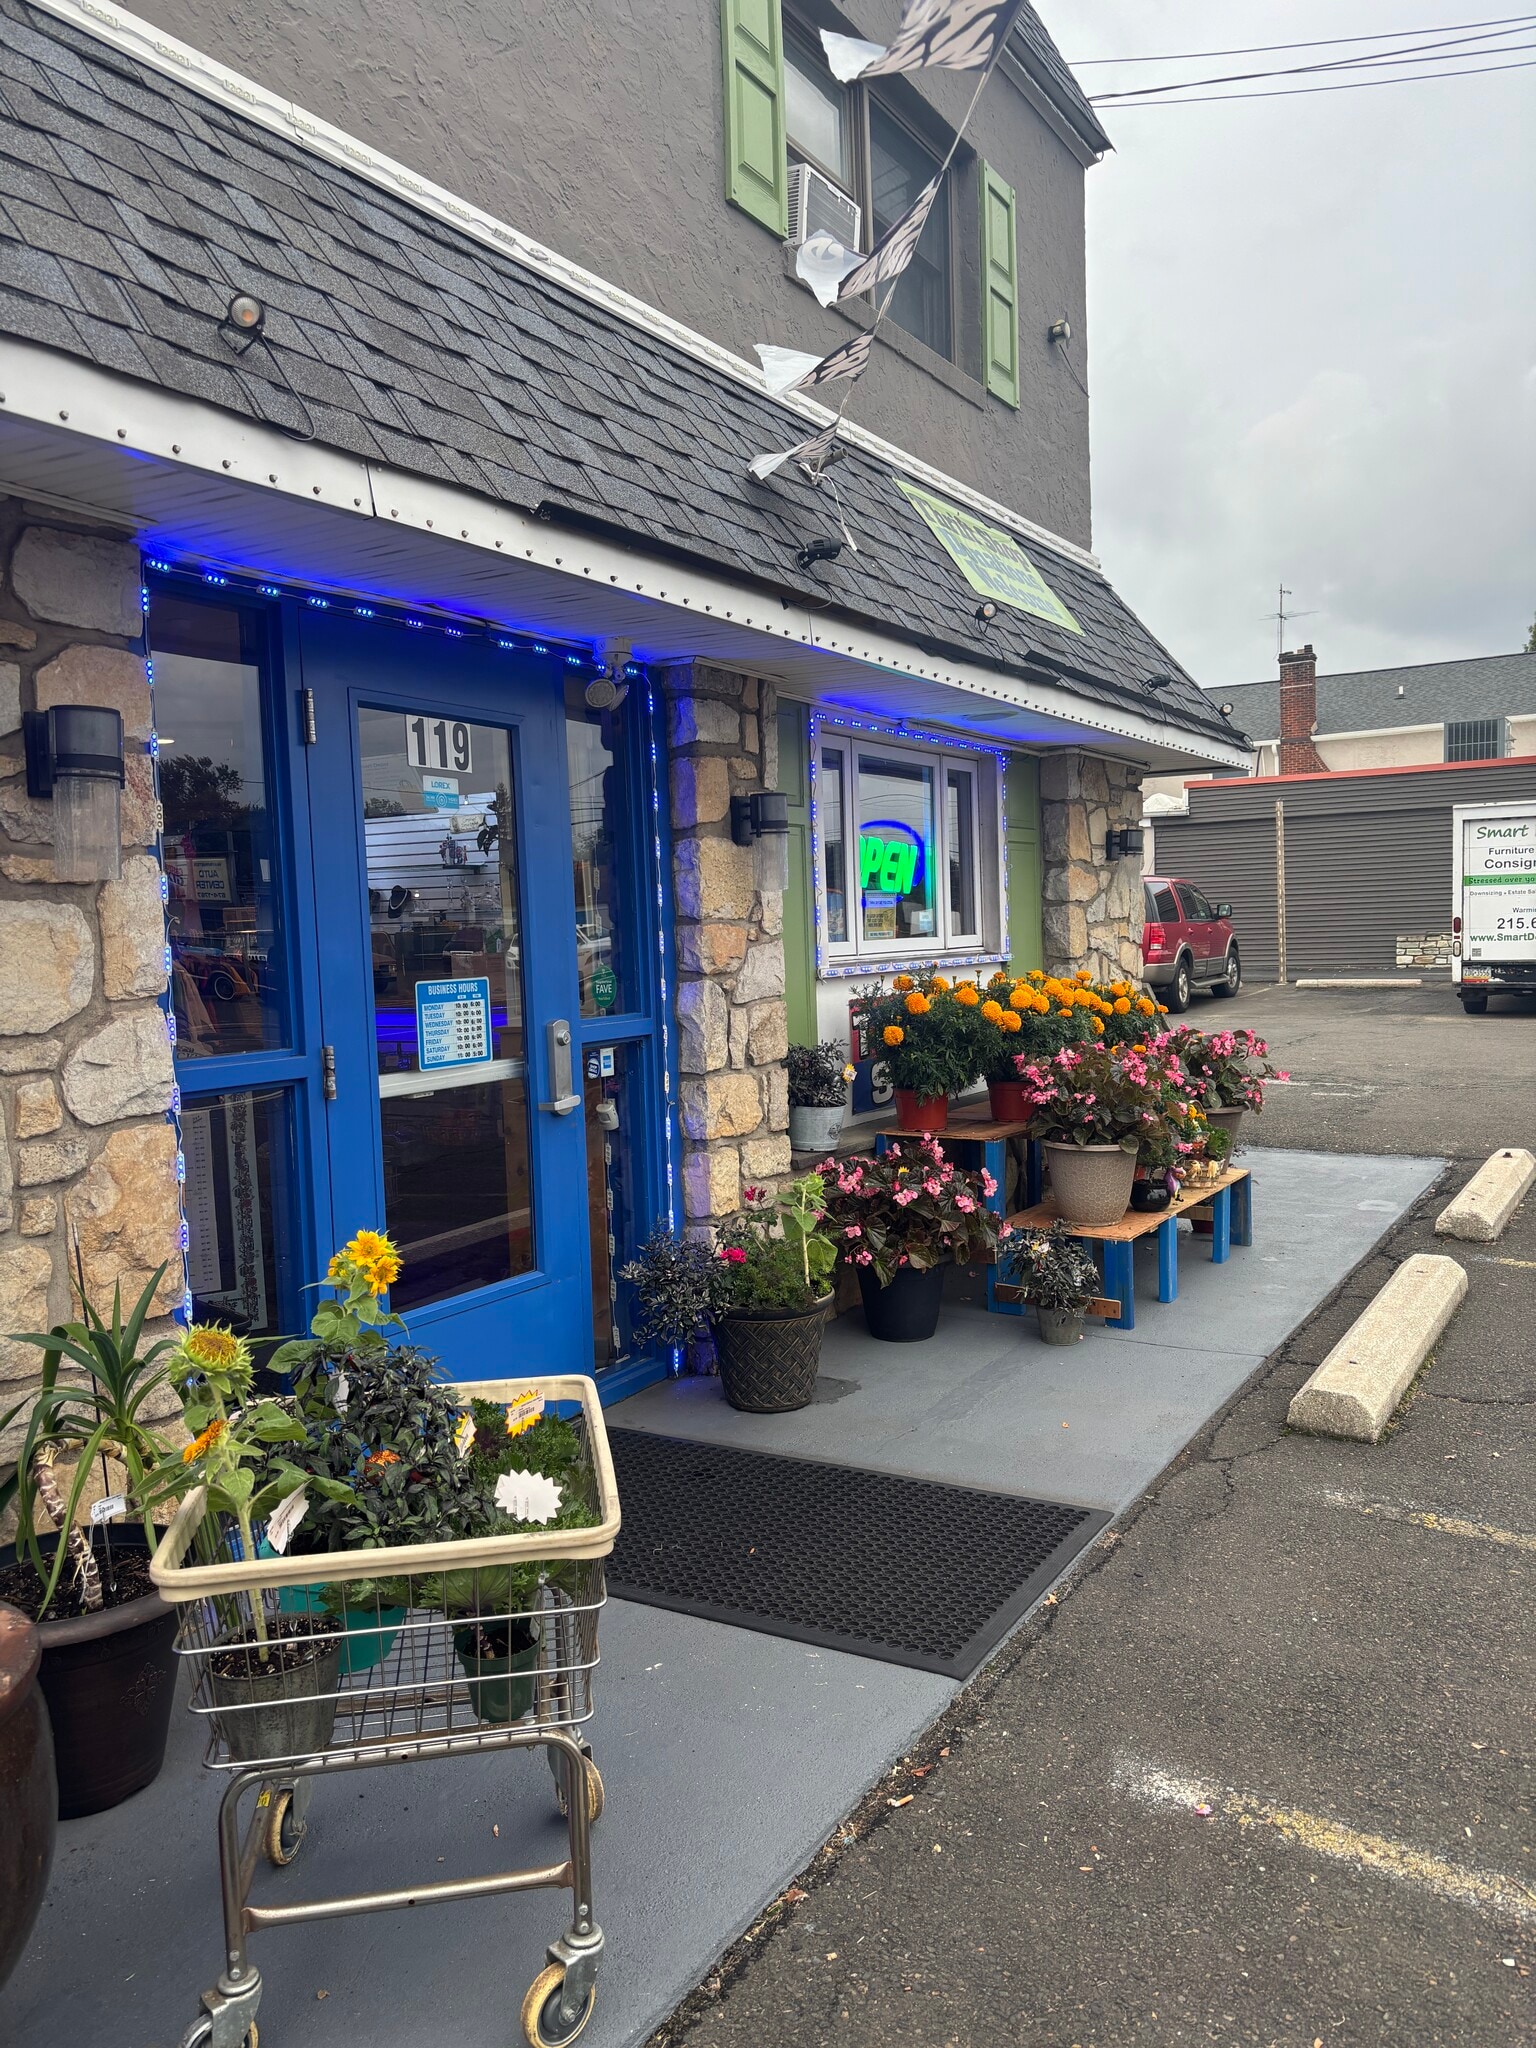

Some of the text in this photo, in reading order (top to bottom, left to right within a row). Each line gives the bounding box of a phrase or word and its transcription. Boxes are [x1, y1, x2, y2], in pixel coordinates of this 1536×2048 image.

[905, 491, 1032, 573] Thrift Shop
[937, 526, 1045, 594] Donations
[964, 558, 1063, 620] Welcome
[411, 717, 470, 771] 119
[431, 780, 451, 790] LOREX
[1476, 824, 1530, 840] Smart
[1488, 846, 1535, 855] Furniture
[1468, 876, 1503, 885] Stressed
[1469, 932, 1536, 942] www.SmartD
[428, 982, 478, 995] BUSINESS HOURS
[595, 984, 613, 994] FAVE
[424, 1012, 446, 1020] TUESDAY
[425, 1020, 453, 1028] WEDNESDAY
[425, 1029, 450, 1037] THURSDAY
[426, 1045, 450, 1054] SATURDAY
[426, 1054, 446, 1062] SUNDAY
